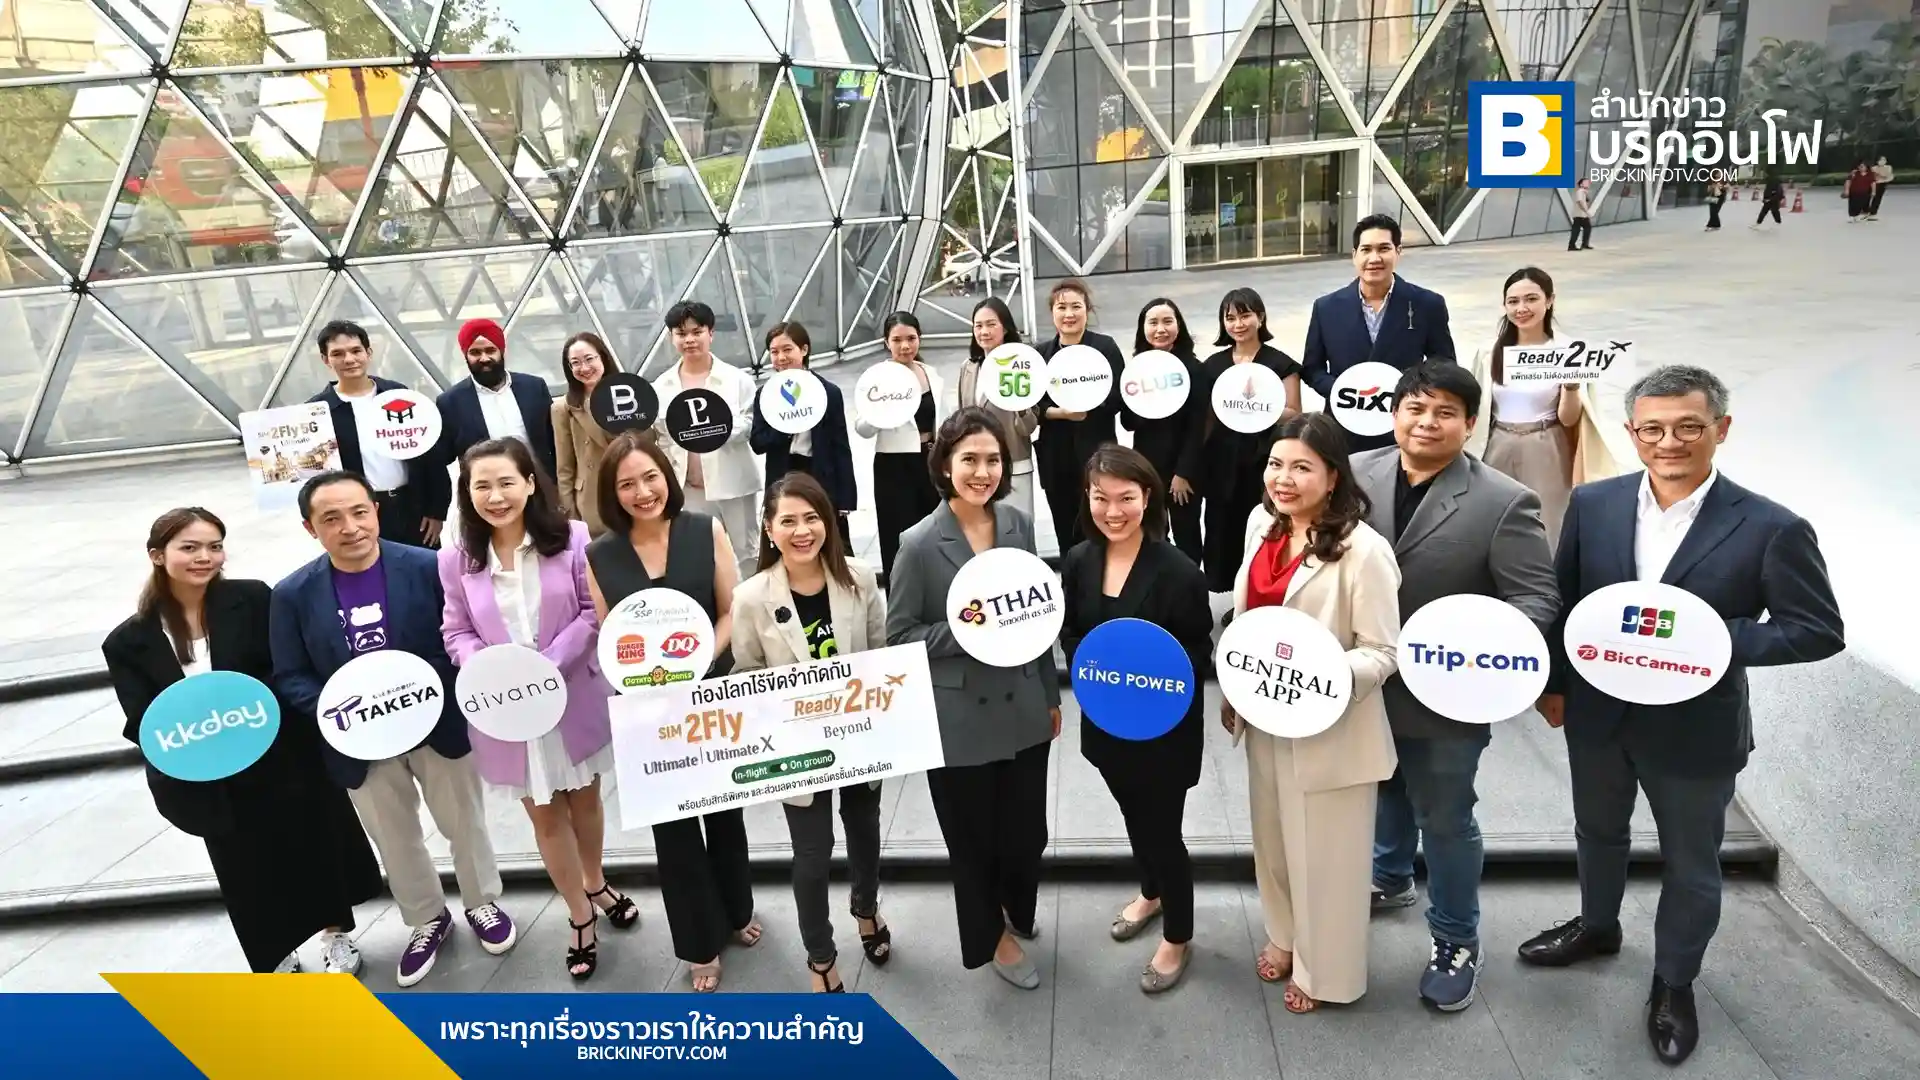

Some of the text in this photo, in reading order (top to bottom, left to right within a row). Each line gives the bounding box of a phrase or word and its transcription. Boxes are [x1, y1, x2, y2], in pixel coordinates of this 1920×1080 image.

[1011, 361, 1031, 370] AIS
[999, 371, 1031, 397] 5G
[1079, 374, 1109, 382] Quijote
[1125, 372, 1184, 396] CLUB
[867, 386, 913, 403] Coral
[1222, 399, 1273, 412] MIRACLE
[606, 412, 647, 422] BLACK TIE
[778, 406, 814, 421] ViMUT
[270, 424, 299, 439] 2Fly
[300, 421, 319, 434] 5G
[375, 426, 428, 439] Hungry
[389, 440, 419, 451] Hub
[986, 582, 1054, 616] THAI
[634, 609, 653, 619] SSP
[998, 603, 1058, 628] Smooth as silk
[1621, 605, 1676, 639] JCB
[816, 624, 834, 639] AI
[616, 643, 645, 652] BURGER
[617, 650, 645, 660] KING
[666, 638, 695, 653] DQ
[1408, 642, 1540, 673] Trip.com
[1225, 650, 1339, 699] CENTRAL
[1603, 649, 1712, 677] BicCamera
[691, 660, 851, 706] ท่องโลกไร้ขีดจำกัดกับ
[1078, 666, 1186, 695] KING POWER
[1255, 679, 1302, 706] APP
[355, 686, 439, 722] TAKEYA
[463, 676, 561, 713] divana
[155, 699, 269, 753] kkday
[658, 708, 743, 743] SIM 2Fly
[823, 717, 873, 741] Beyond
[643, 735, 776, 775] Ultimate Ultimate X
[734, 753, 833, 781] In-flight On ground
